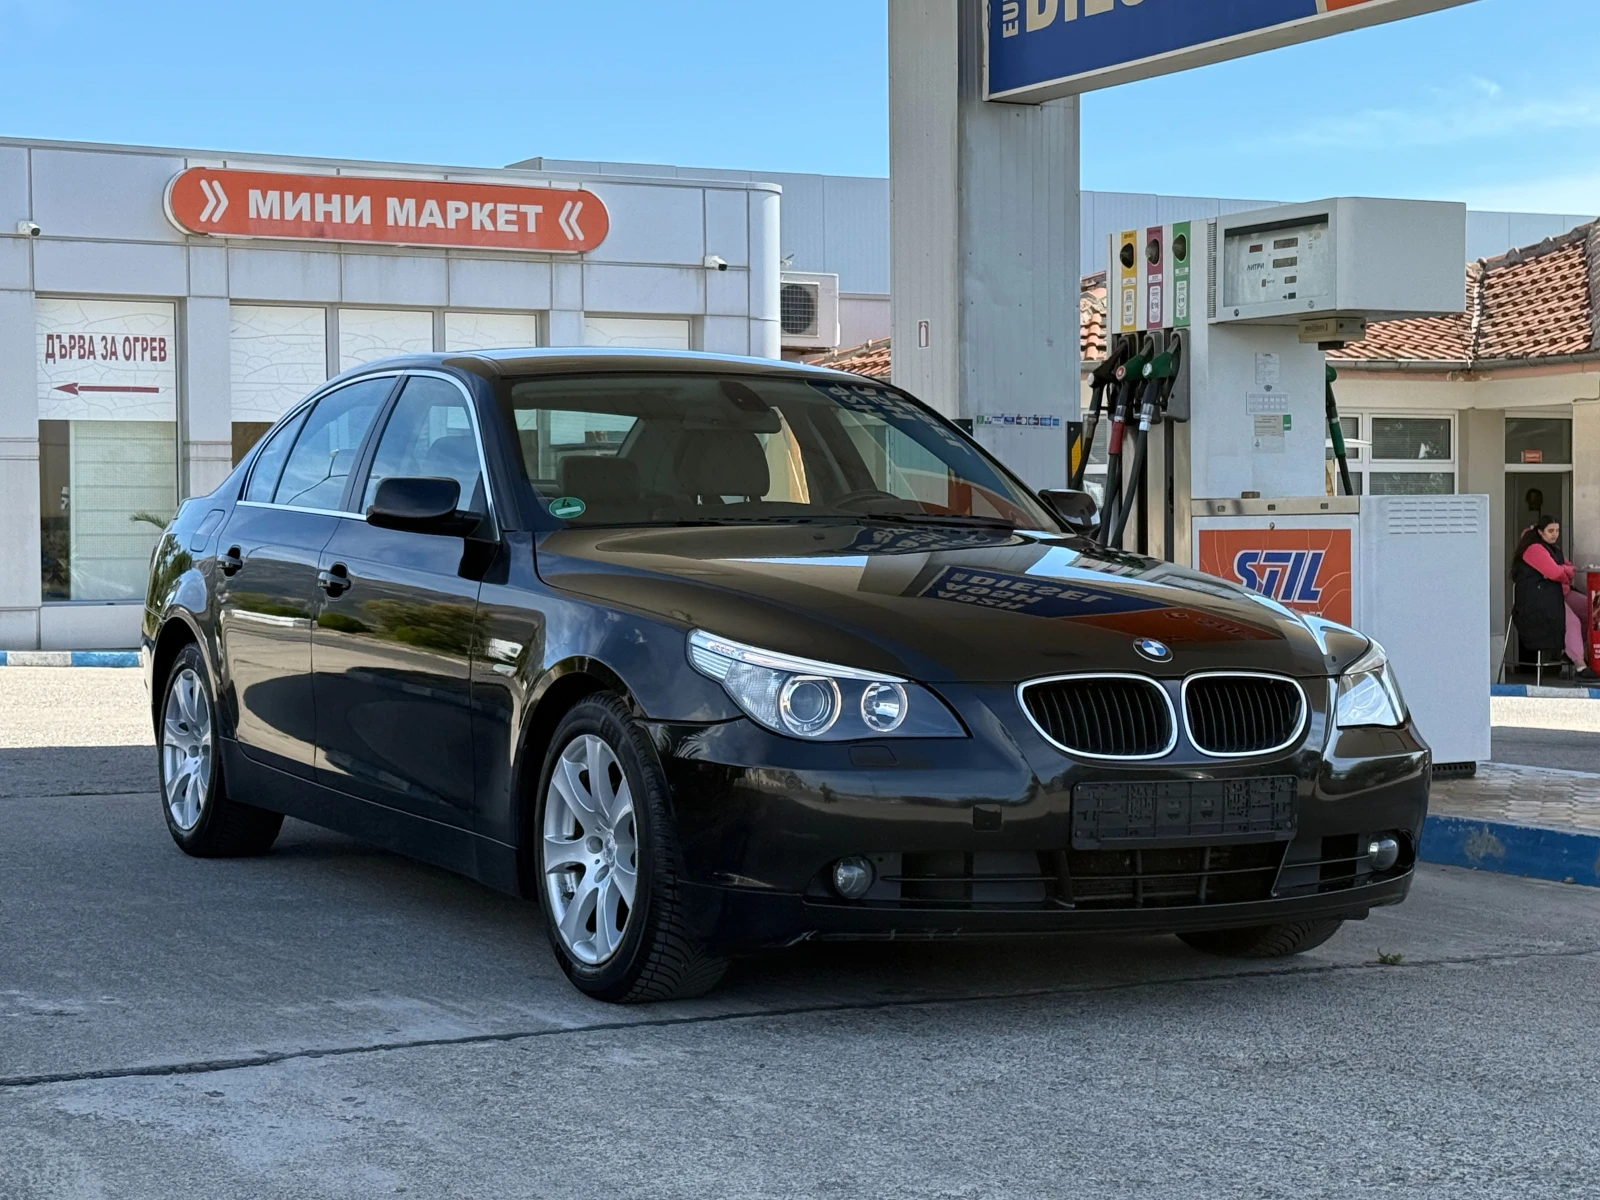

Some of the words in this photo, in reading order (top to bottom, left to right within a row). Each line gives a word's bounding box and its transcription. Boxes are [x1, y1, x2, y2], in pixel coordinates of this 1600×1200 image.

[1002, 0, 1020, 39] EU
[248, 188, 372, 225] МИНИ
[386, 196, 543, 233] МАРКЕТ
[45, 333, 97, 365] ДЪРВА
[100, 335, 118, 361] ЗА
[122, 335, 167, 362] ОГРЕВ
